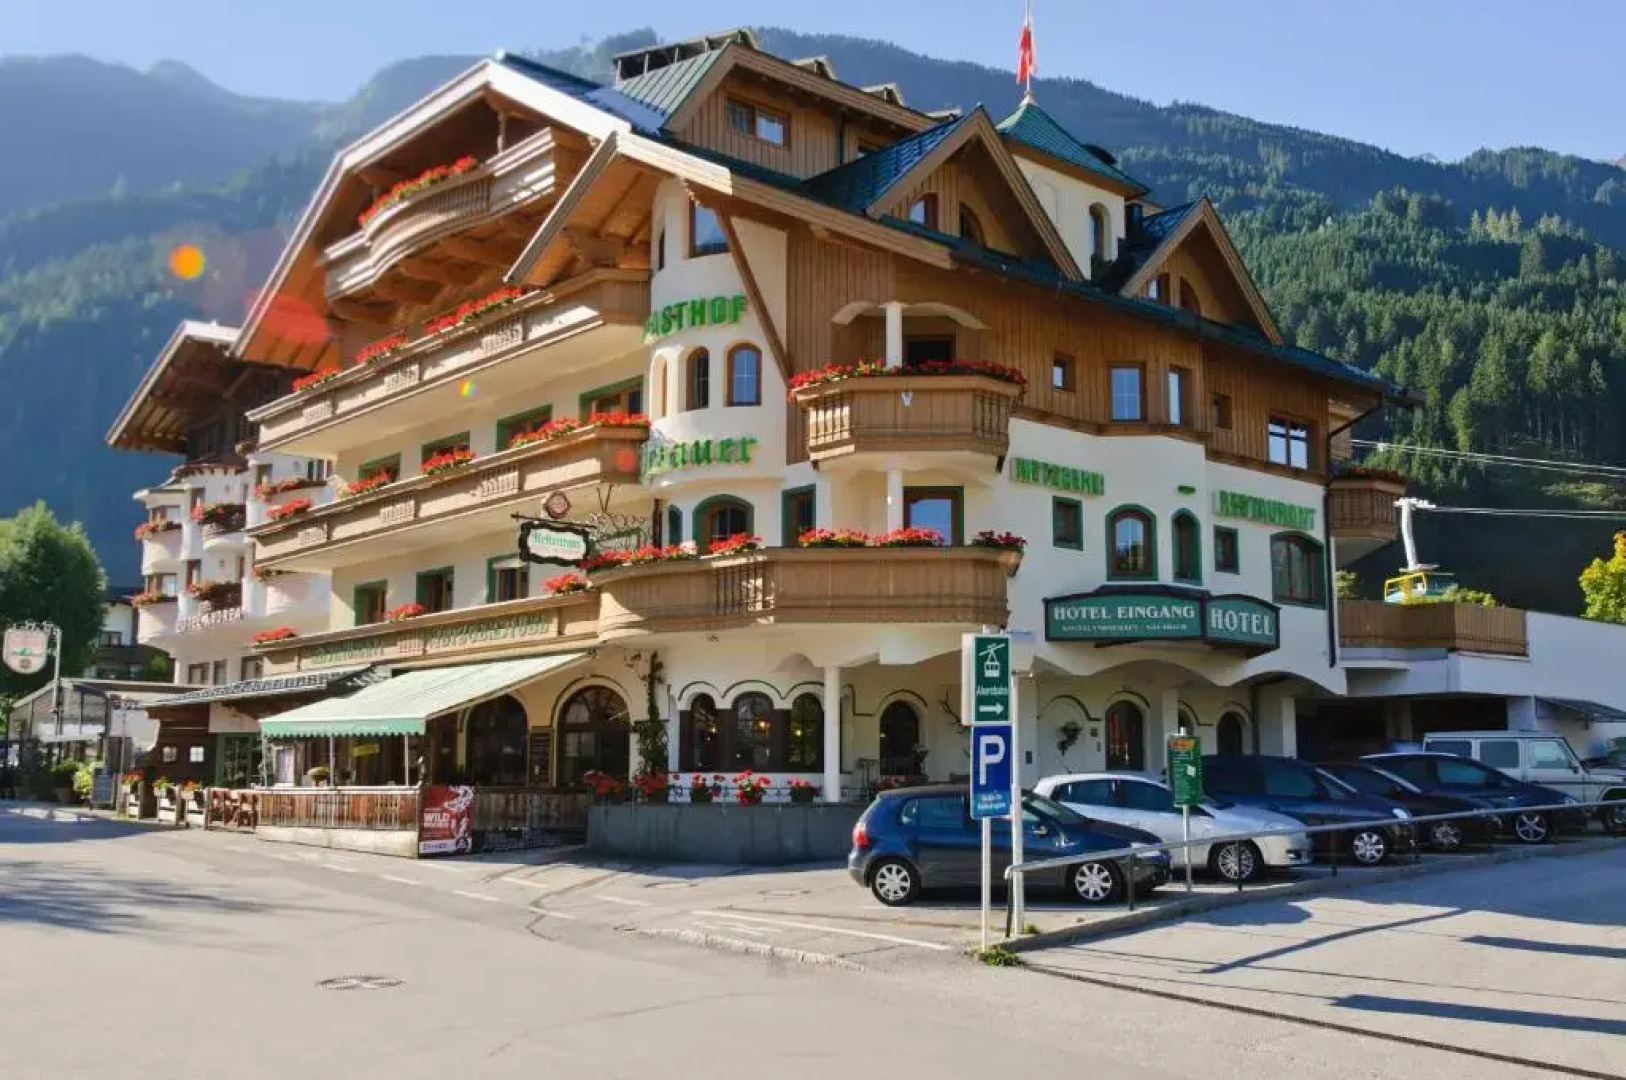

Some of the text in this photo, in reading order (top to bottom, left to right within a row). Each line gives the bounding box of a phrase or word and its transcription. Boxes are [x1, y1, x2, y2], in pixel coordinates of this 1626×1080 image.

[645, 295, 748, 336] ASTHOF
[1219, 490, 1317, 530] RESTAURANT
[1053, 605, 1195, 621] HOTEL EINGANG
[1209, 607, 1274, 636] HOTEL
[979, 734, 1006, 786] P
